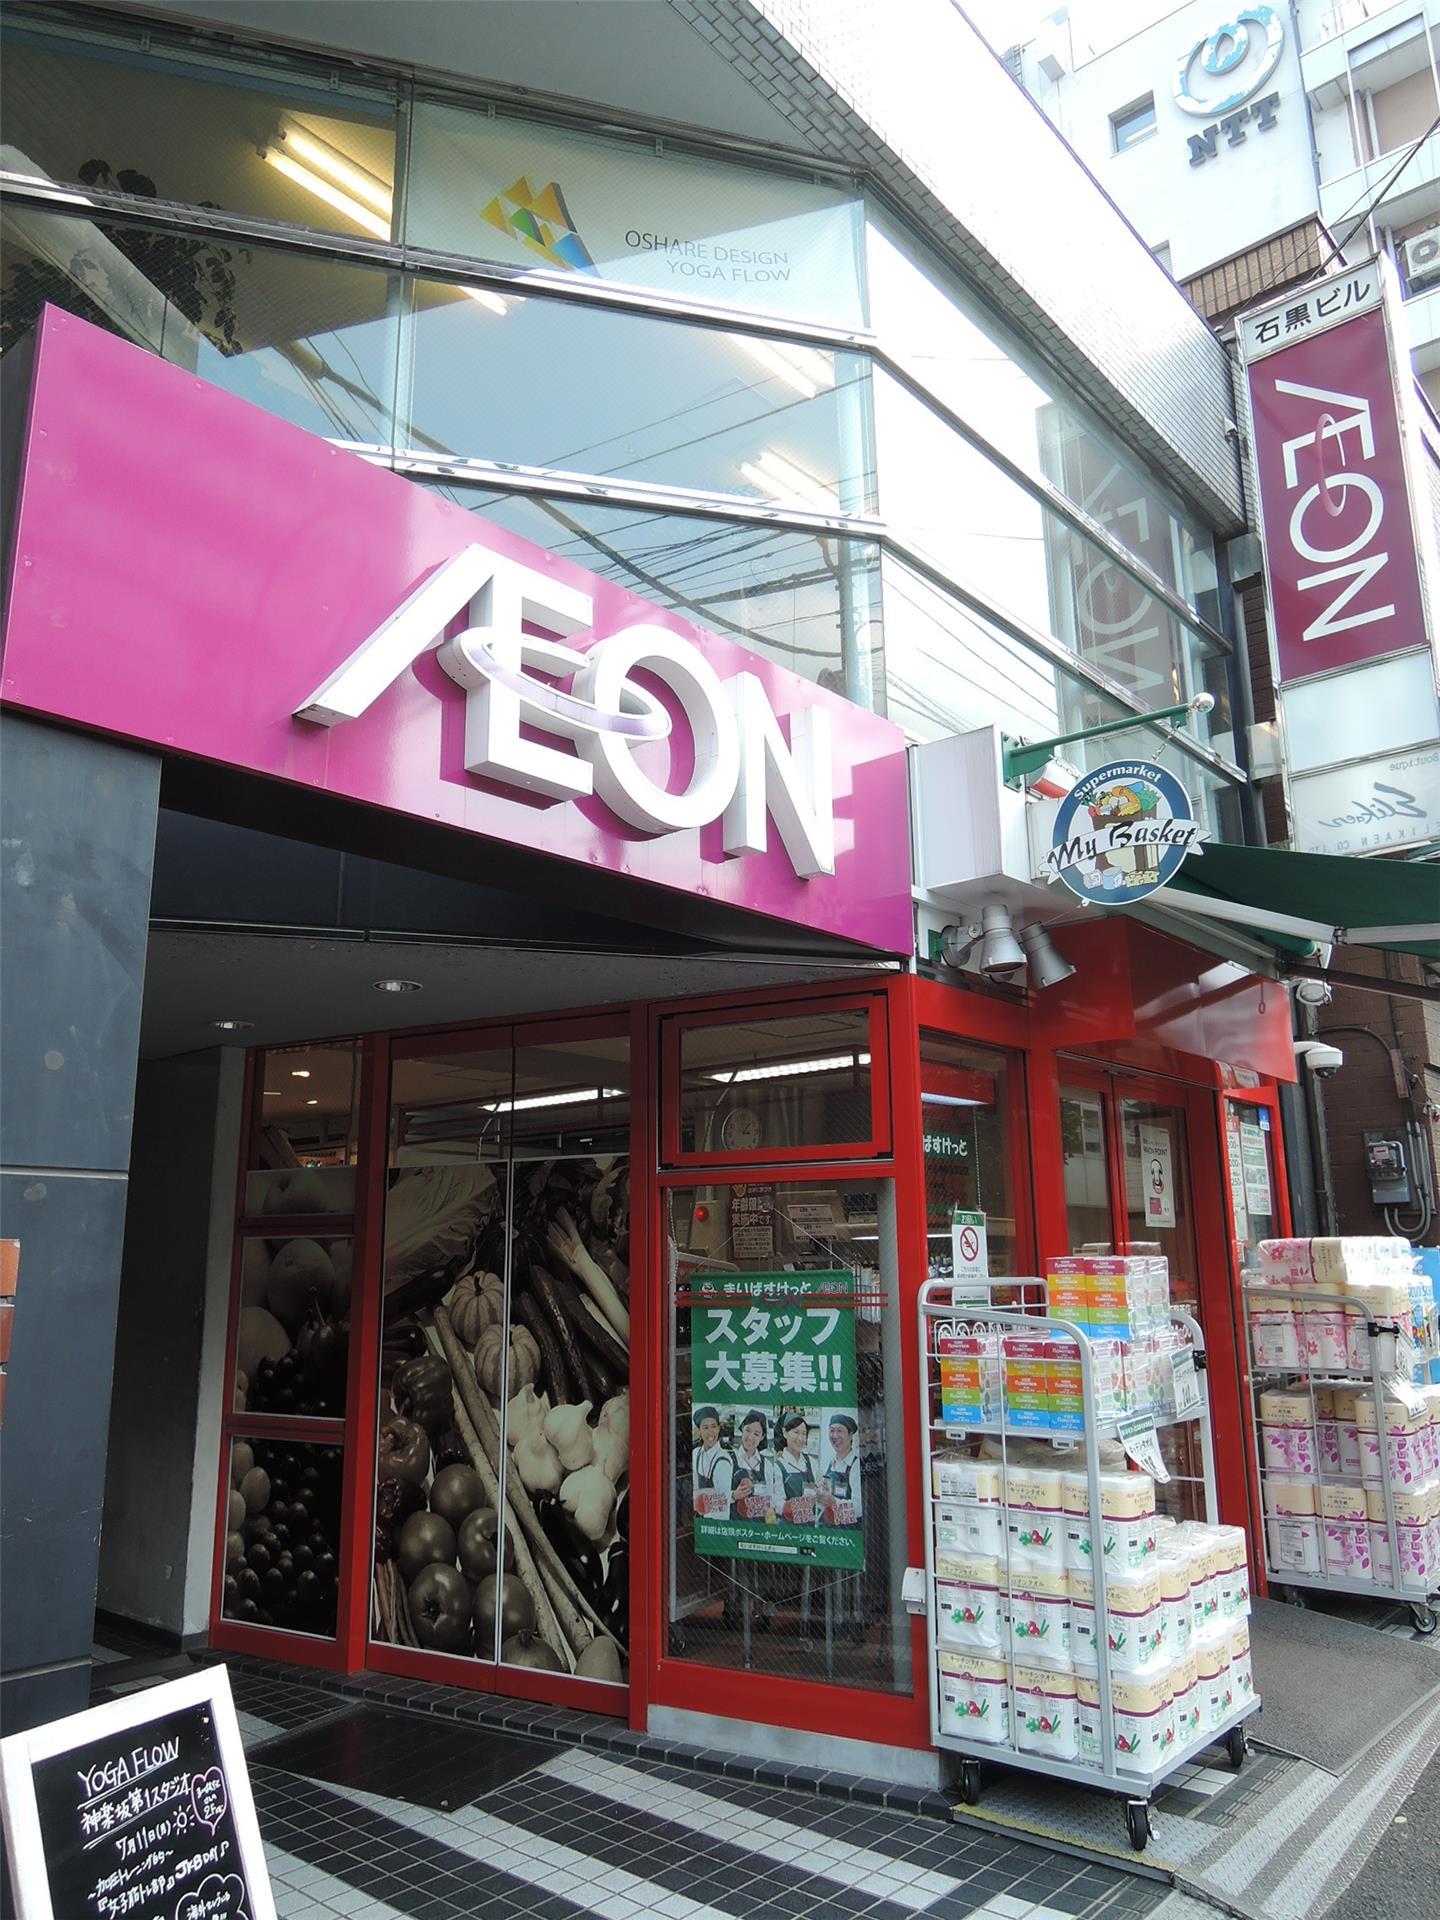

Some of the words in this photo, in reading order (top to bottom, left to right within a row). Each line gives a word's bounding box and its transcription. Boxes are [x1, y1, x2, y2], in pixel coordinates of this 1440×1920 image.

[1186, 91, 1280, 168] NTT
[625, 230, 707, 259] OSHARE
[714, 246, 788, 265] DESIGN
[666, 260, 727, 280] YOGA
[732, 268, 791, 282] FLOW
[1255, 280, 1371, 343] 石黒ビル
[1275, 378, 1396, 642] AEON
[291, 543, 836, 880] AEON
[1074, 765, 1162, 801] Supermarket
[1047, 836, 1097, 871] My
[1109, 819, 1197, 848] Basket
[705, 1306, 841, 1346] スタッフ
[705, 1350, 843, 1393] 大募集!!
[77, 1756, 130, 1798] YOGA
[131, 1736, 180, 1777] FLOW
[80, 1772, 191, 1835] 神楽坂第1スタジオ
